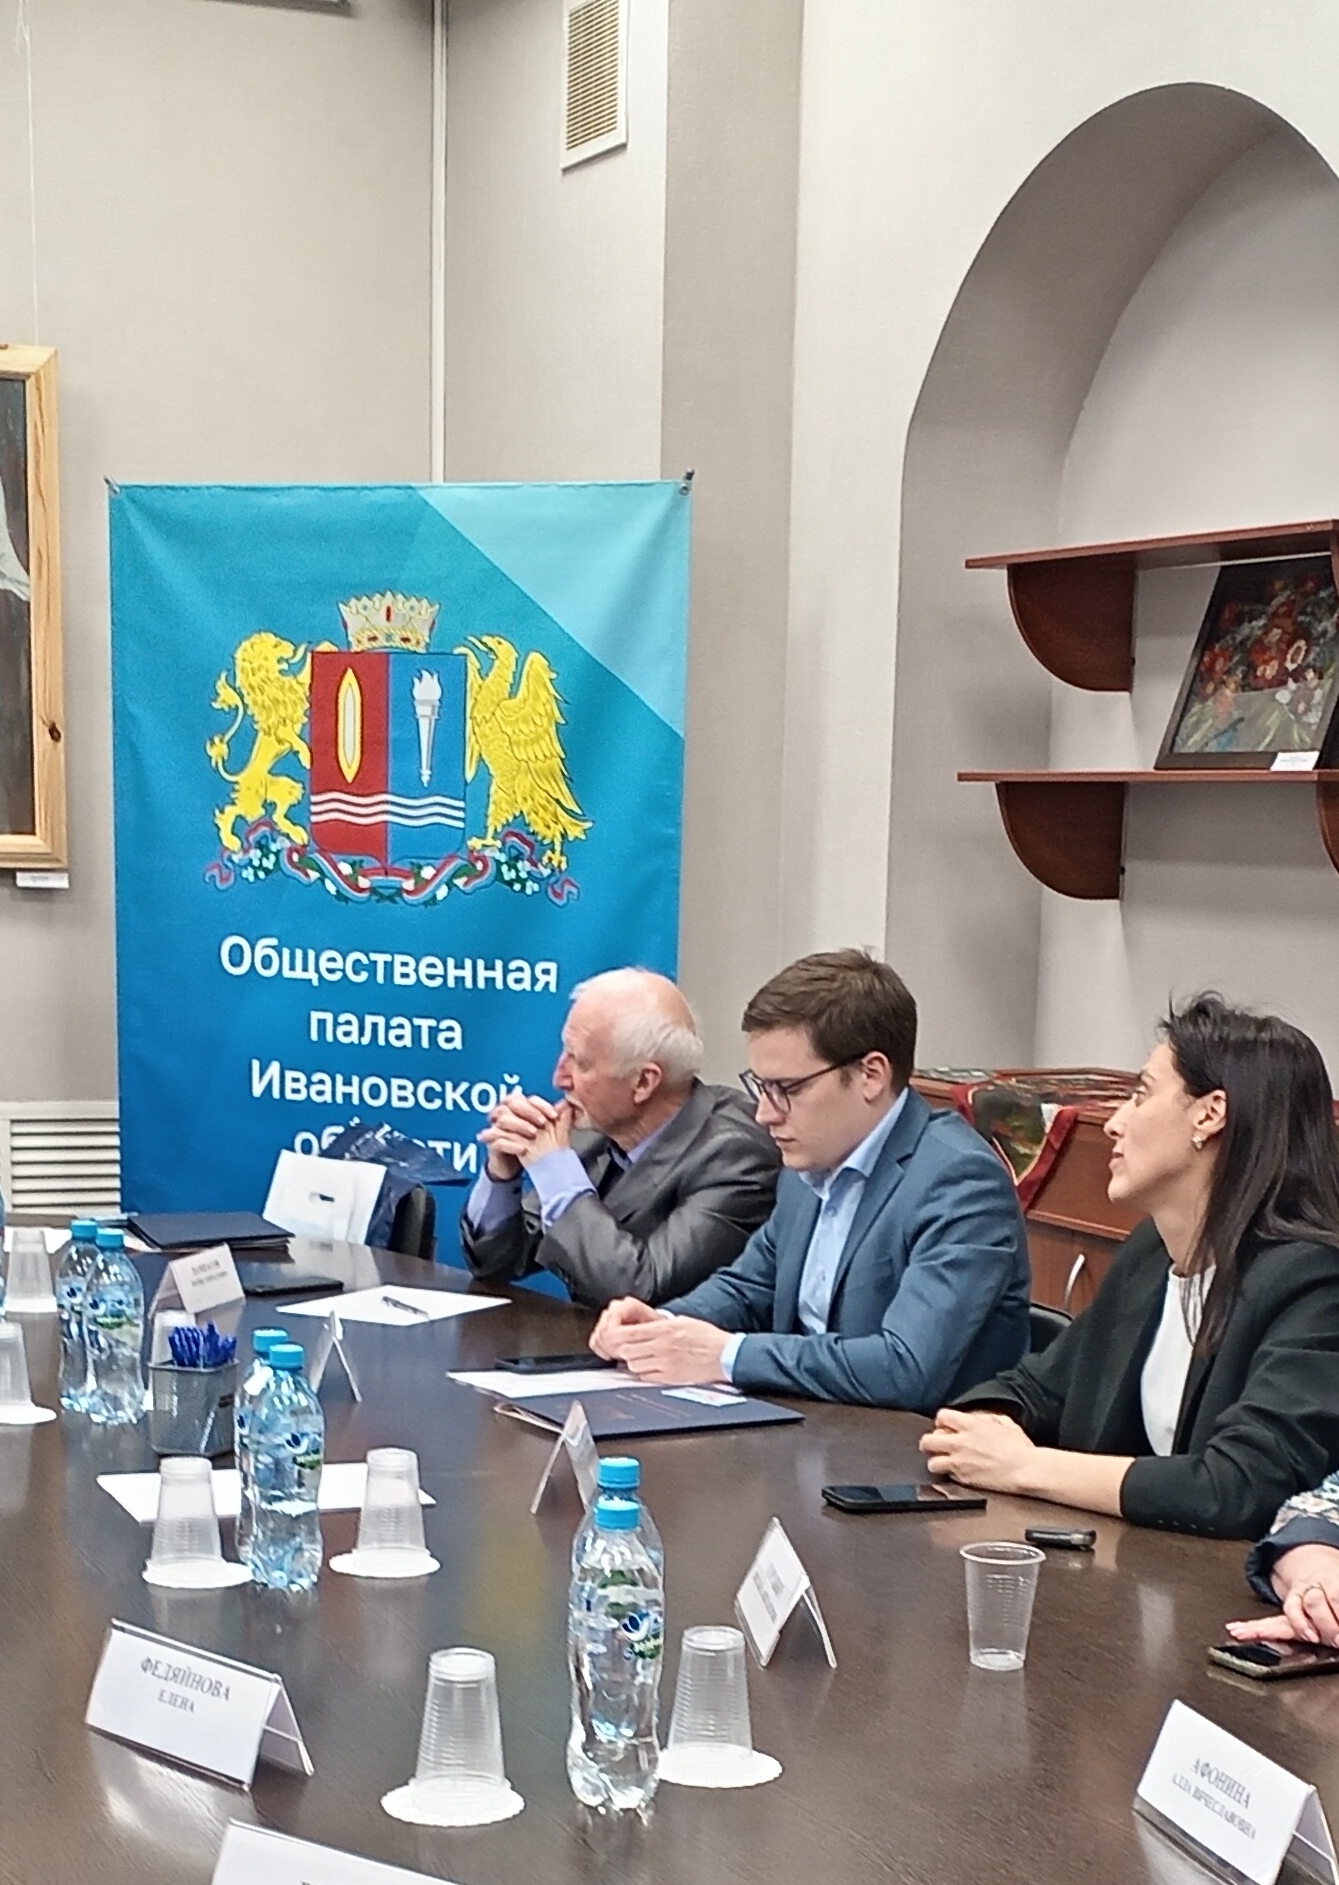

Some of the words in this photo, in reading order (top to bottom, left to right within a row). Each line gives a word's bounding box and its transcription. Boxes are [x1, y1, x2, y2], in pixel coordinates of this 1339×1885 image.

[220, 934, 558, 993] Общественная
[309, 1009, 462, 1050] палата
[141, 1657, 230, 1700] ФЕДЯЙНОВА
[158, 1690, 194, 1712] ЕЛЕНА
[1192, 1759, 1251, 1808] АФОНИНА
